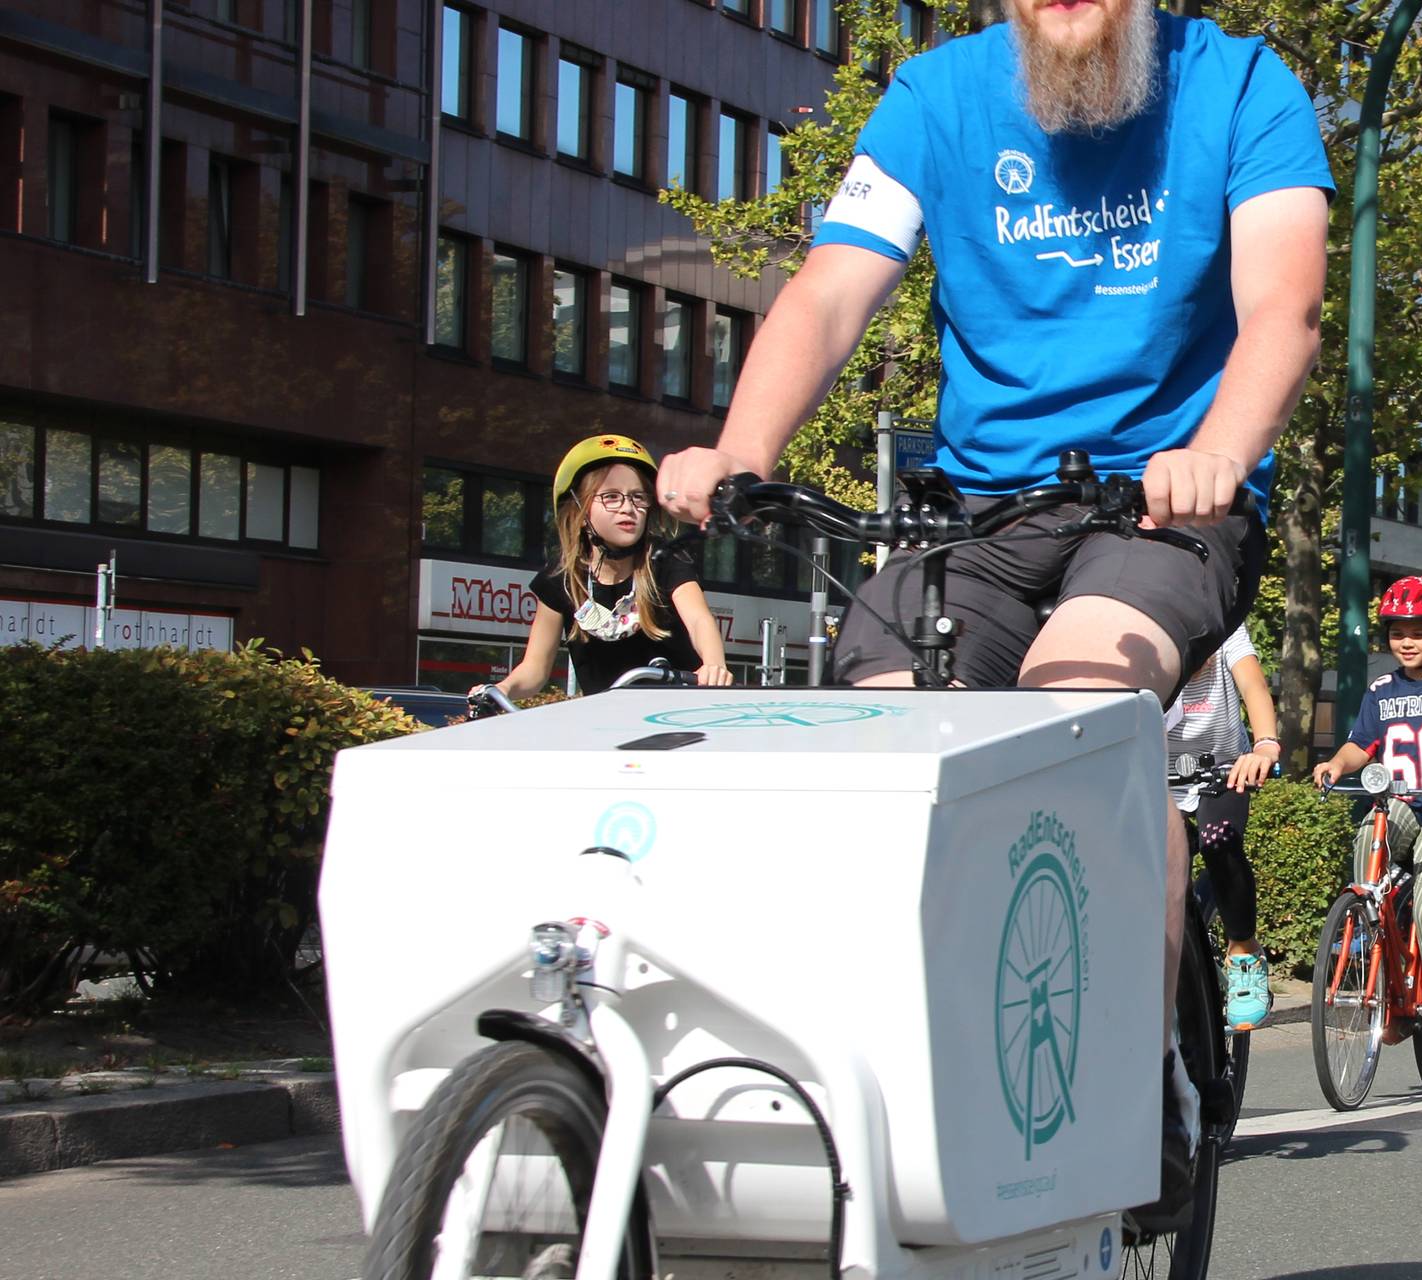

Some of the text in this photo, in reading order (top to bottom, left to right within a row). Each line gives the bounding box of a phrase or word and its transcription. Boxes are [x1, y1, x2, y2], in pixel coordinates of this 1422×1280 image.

[840, 180, 872, 200] NER
[994, 188, 1153, 245] RadEntscheid
[452, 576, 538, 625] Miele
[0, 611, 56, 636] ardt
[113, 619, 214, 647] rothhardt
[1008, 809, 1090, 913] RadEntscheid
